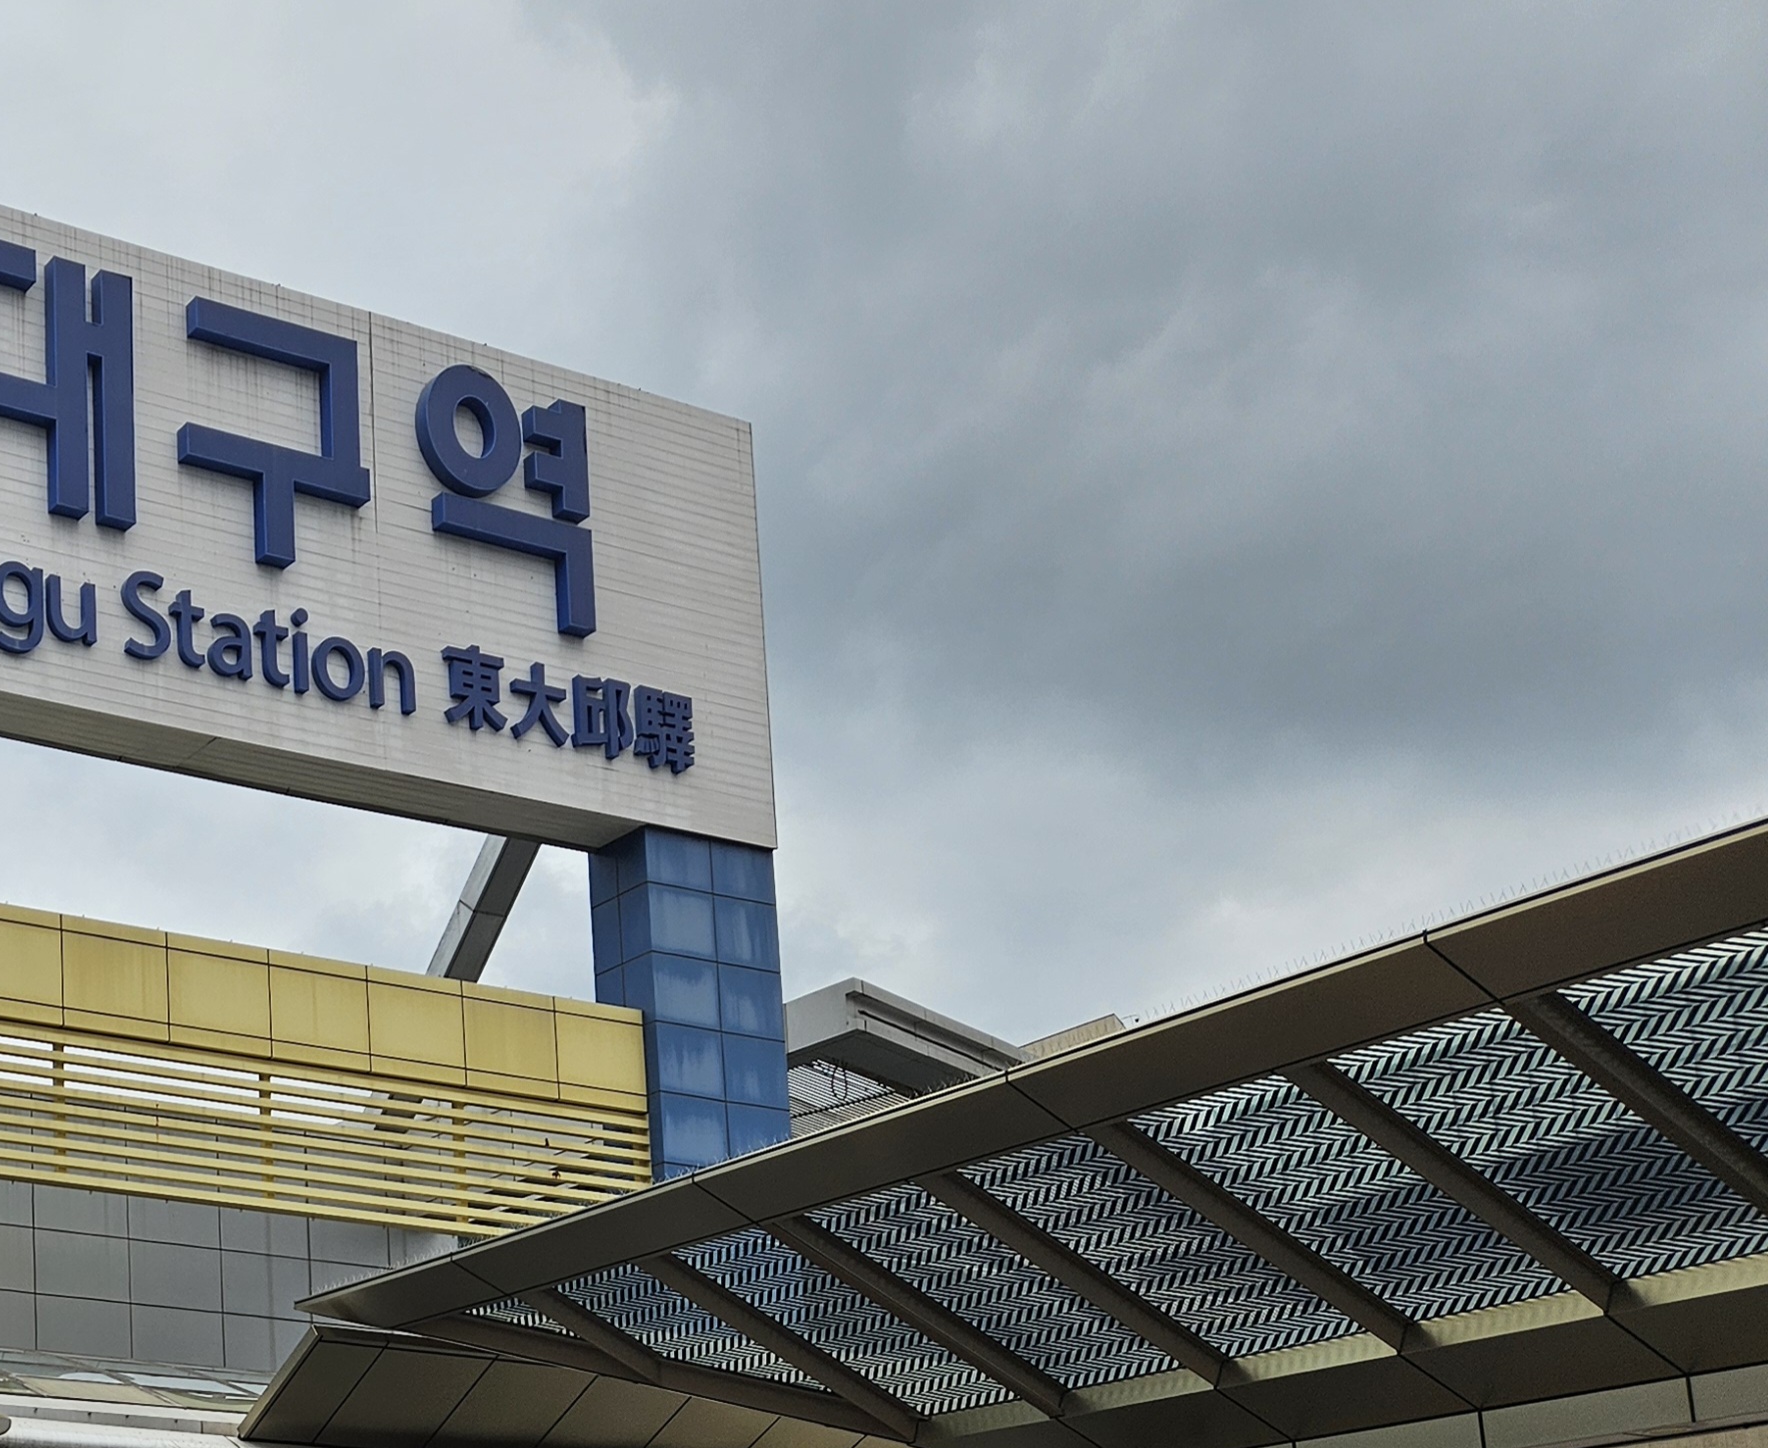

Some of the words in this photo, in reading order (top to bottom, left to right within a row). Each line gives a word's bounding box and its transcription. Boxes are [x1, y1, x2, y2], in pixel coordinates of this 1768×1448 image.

[123, 570, 416, 716] Station
[441, 644, 694, 775] 東大邱驛
